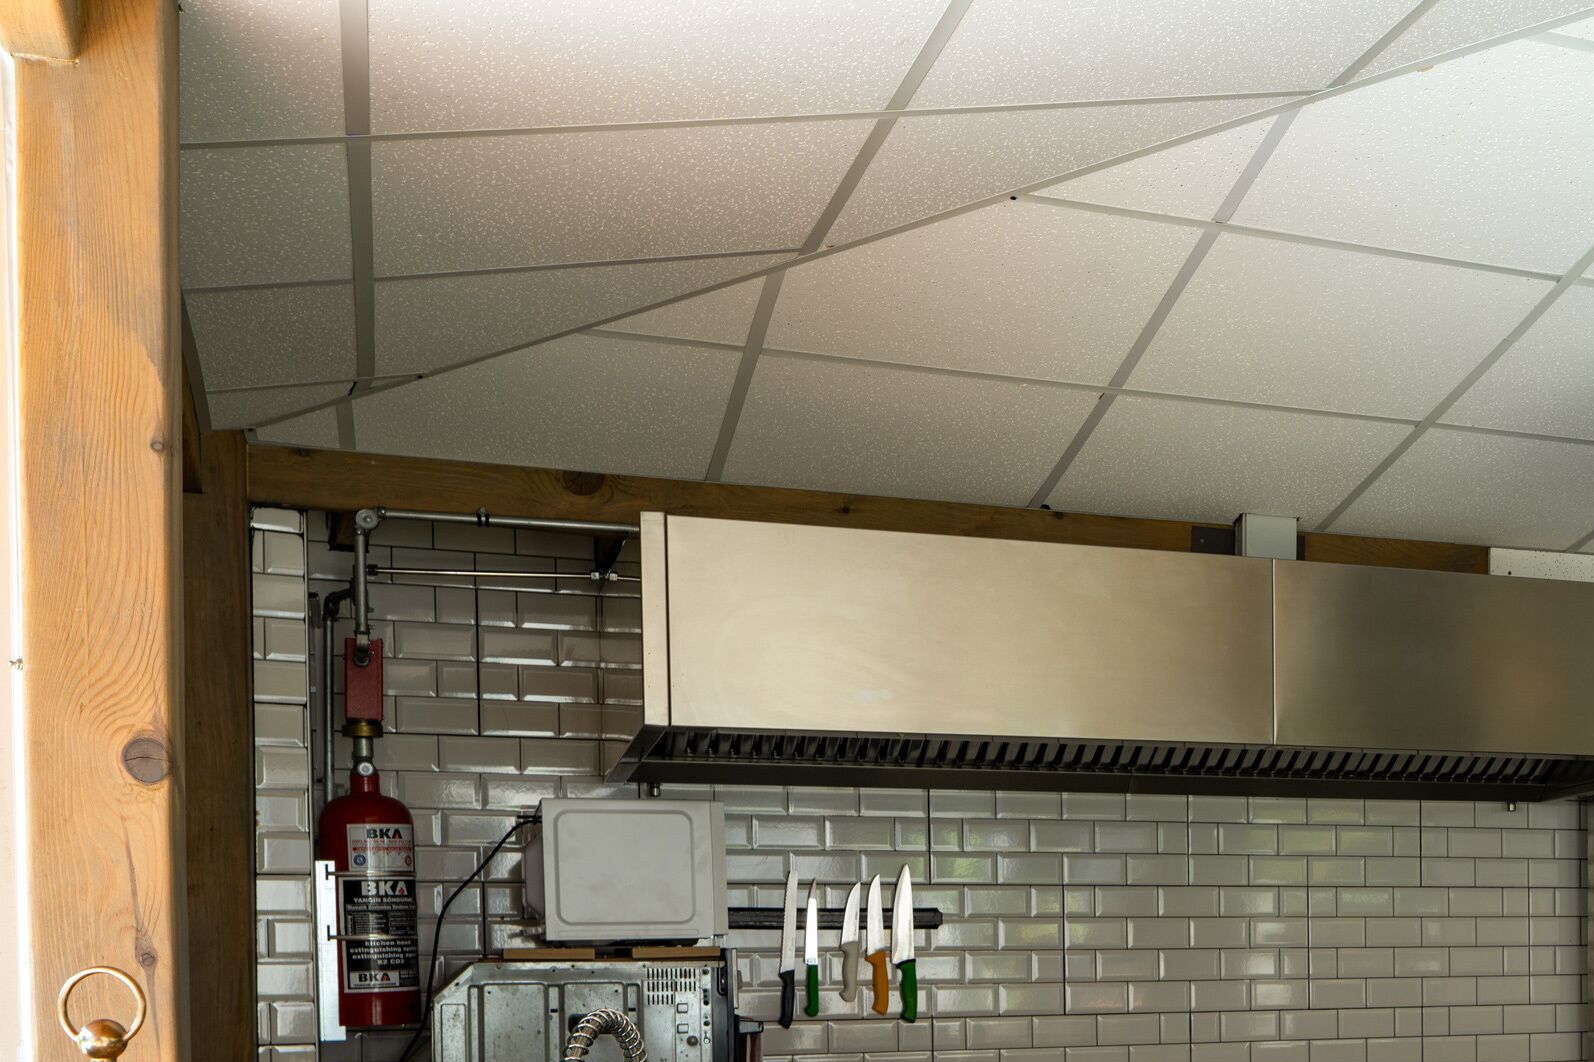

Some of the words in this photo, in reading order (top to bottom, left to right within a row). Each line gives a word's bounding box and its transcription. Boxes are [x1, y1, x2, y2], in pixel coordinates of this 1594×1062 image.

[366, 828, 403, 840] BKA
[361, 880, 408, 896] BKA
[365, 939, 395, 947] kitchen
[358, 972, 391, 982] BKA
